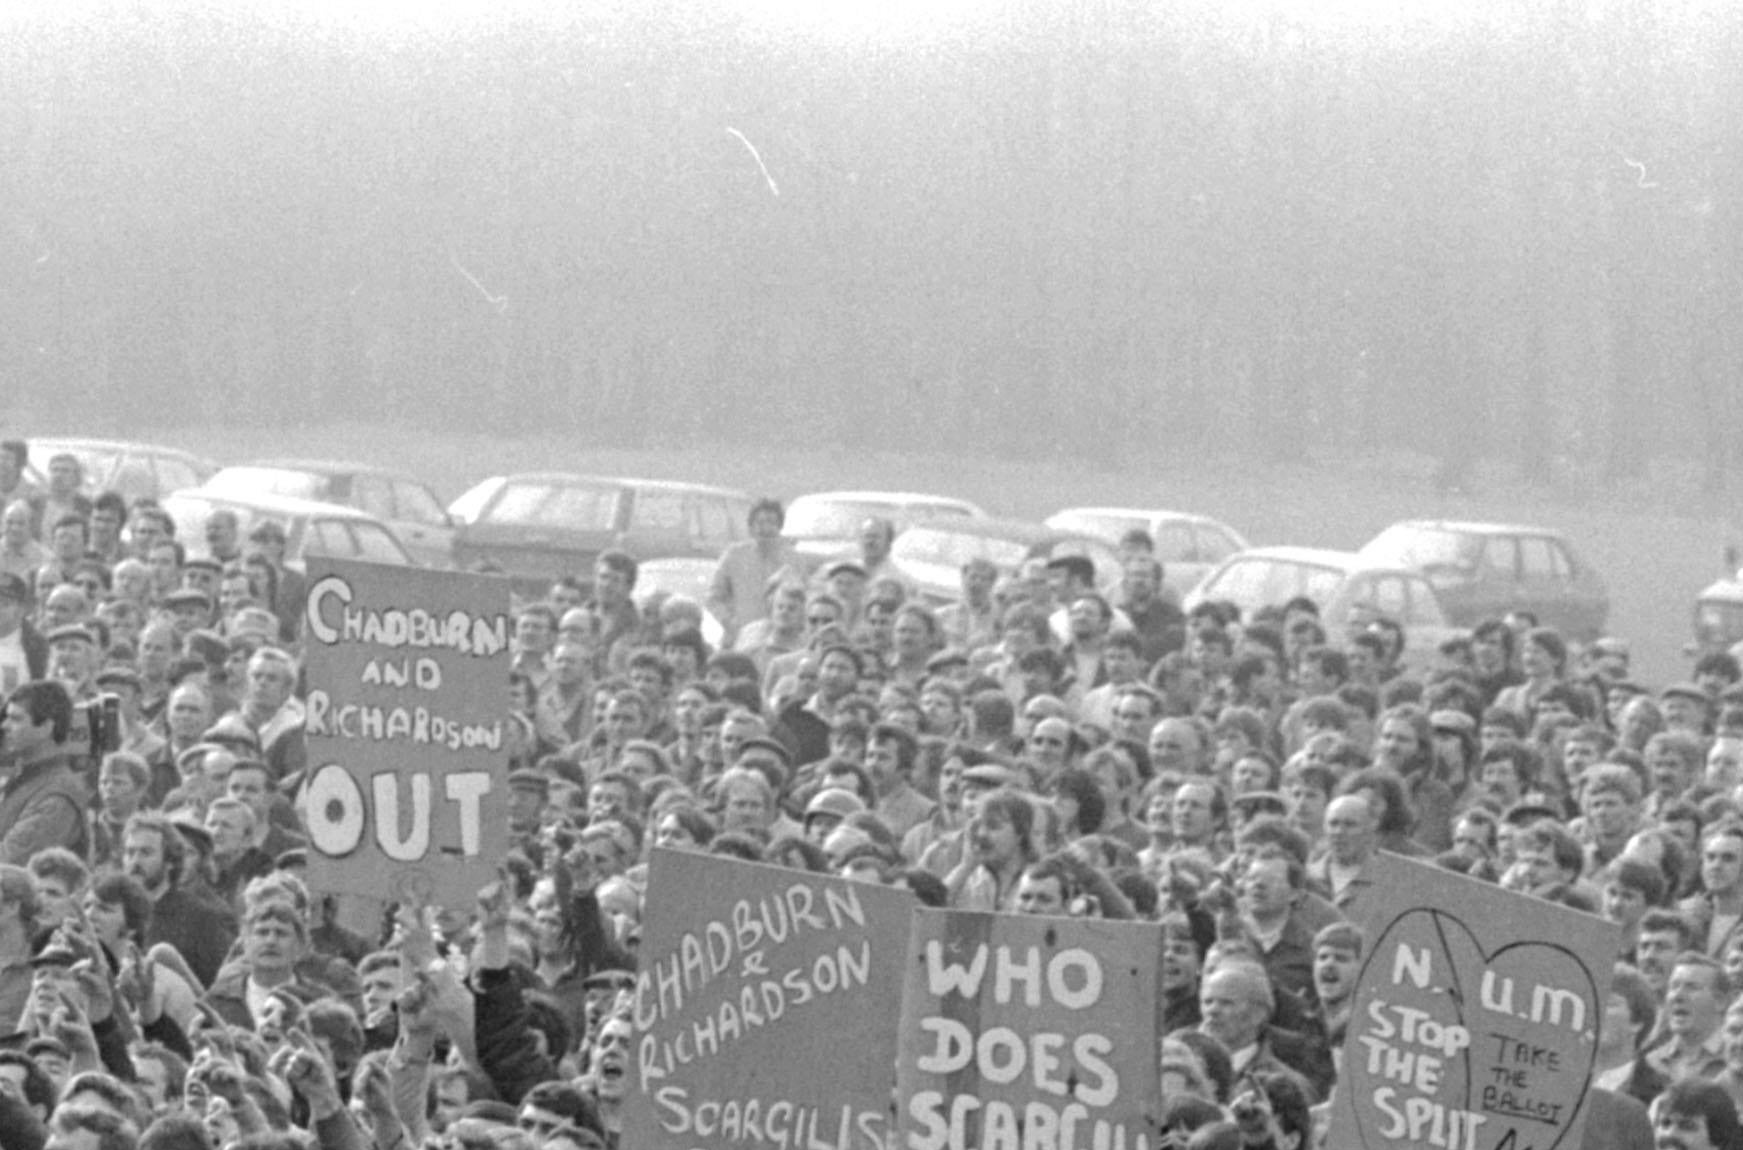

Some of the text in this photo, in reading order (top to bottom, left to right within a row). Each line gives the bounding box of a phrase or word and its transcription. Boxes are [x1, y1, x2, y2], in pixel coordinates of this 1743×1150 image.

[307, 576, 506, 656] CHADBURN
[362, 658, 441, 690] AND
[306, 689, 502, 750] RICHARDSON
[306, 764, 491, 862] OUT
[634, 884, 865, 1032] CHADBURN
[926, 939, 1103, 1010] WHO
[639, 940, 871, 1093] RICHARDSON
[917, 1016, 1119, 1107] DOES
[1358, 1034, 1442, 1095] THE
[1489, 1032, 1562, 1072] TAKE
[1490, 1066, 1528, 1089] THE
[1482, 1085, 1564, 1119] BALLOT
